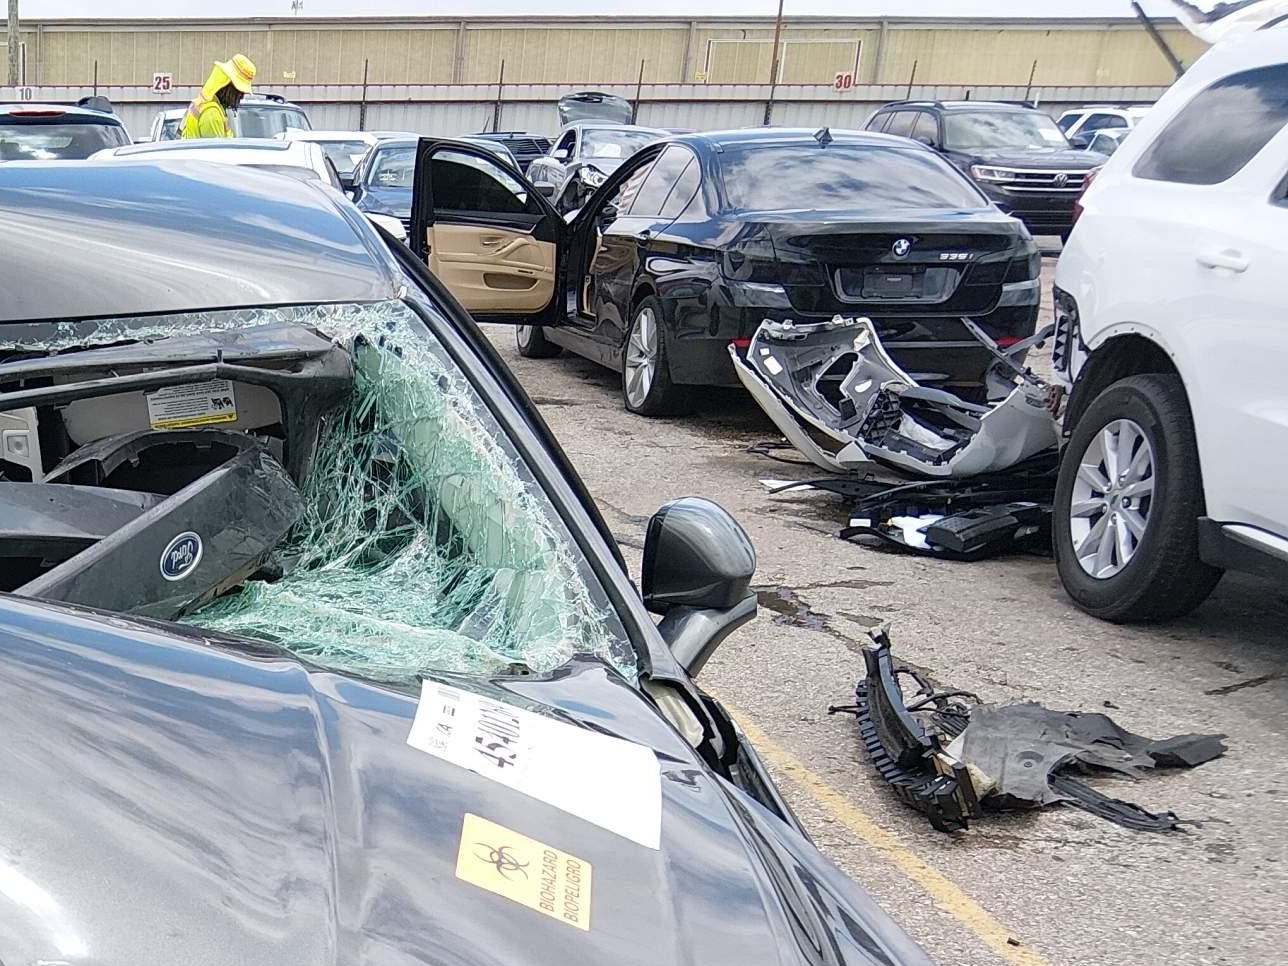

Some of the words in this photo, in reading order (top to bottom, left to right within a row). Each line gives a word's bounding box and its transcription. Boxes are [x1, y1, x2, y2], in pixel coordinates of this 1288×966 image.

[155, 76, 170, 90] 25
[835, 74, 852, 89] 30
[19, 87, 32, 100] 10
[539, 849, 558, 913] BIOHAZARD
[563, 859, 582, 923] BIOPELIGRO
